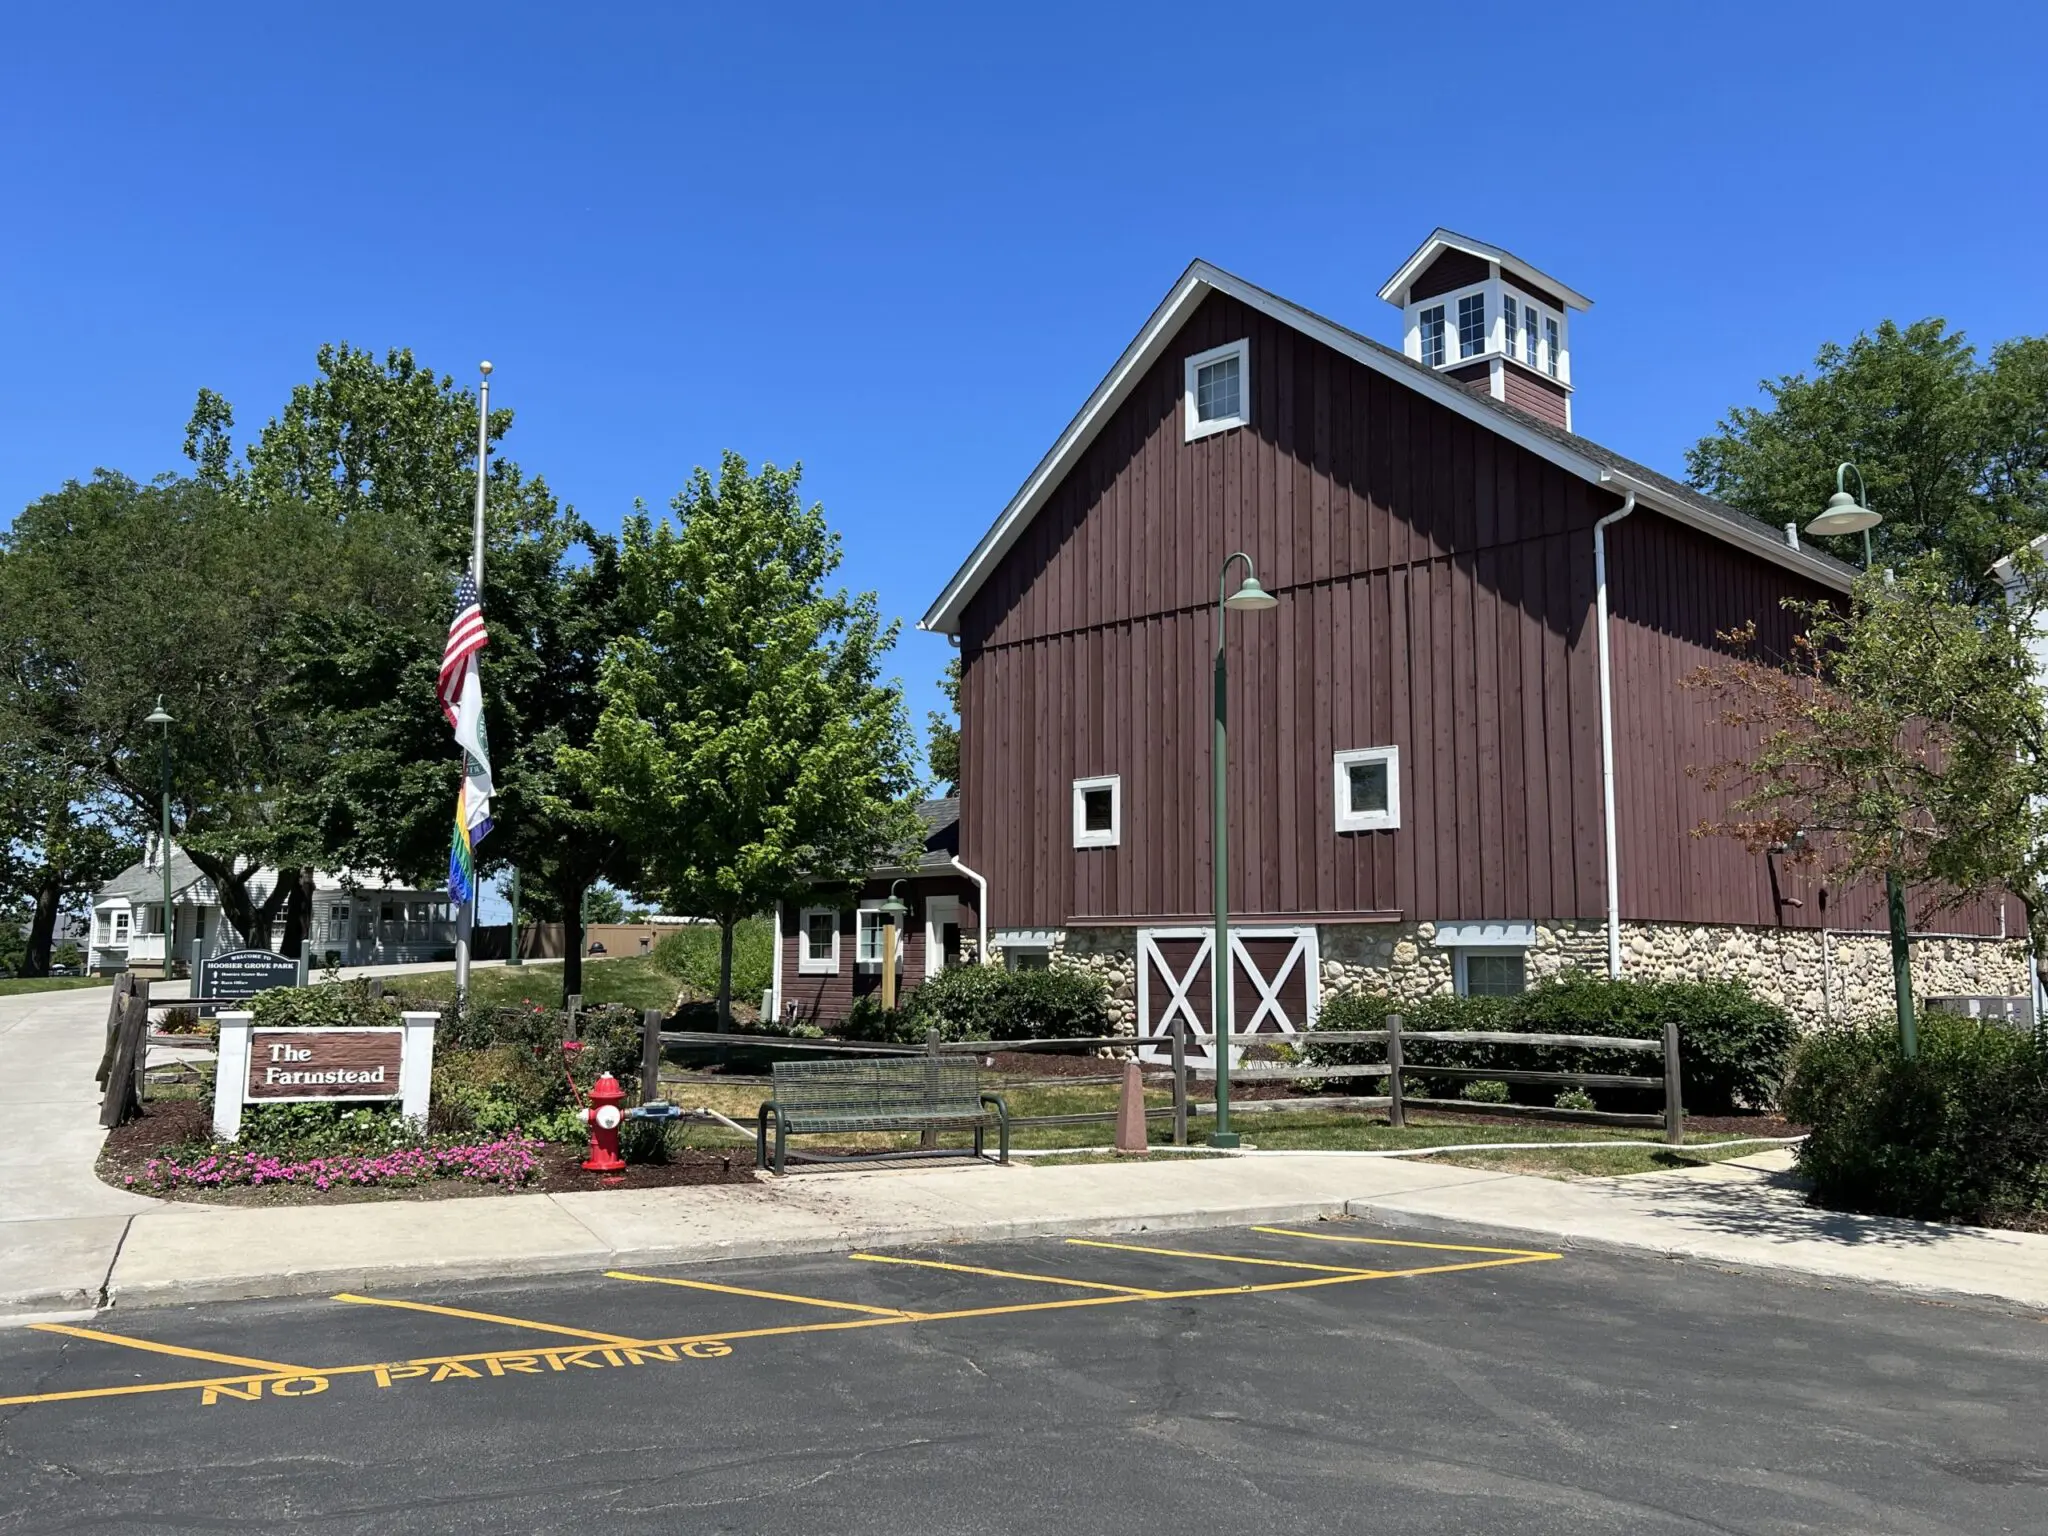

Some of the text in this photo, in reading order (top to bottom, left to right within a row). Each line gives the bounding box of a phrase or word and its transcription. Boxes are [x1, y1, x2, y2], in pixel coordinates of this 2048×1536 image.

[231, 953, 261, 961] WELCOME
[268, 1044, 312, 1063] The
[265, 1066, 385, 1085] Farmstead
[201, 1340, 733, 1406] NO PARKING
